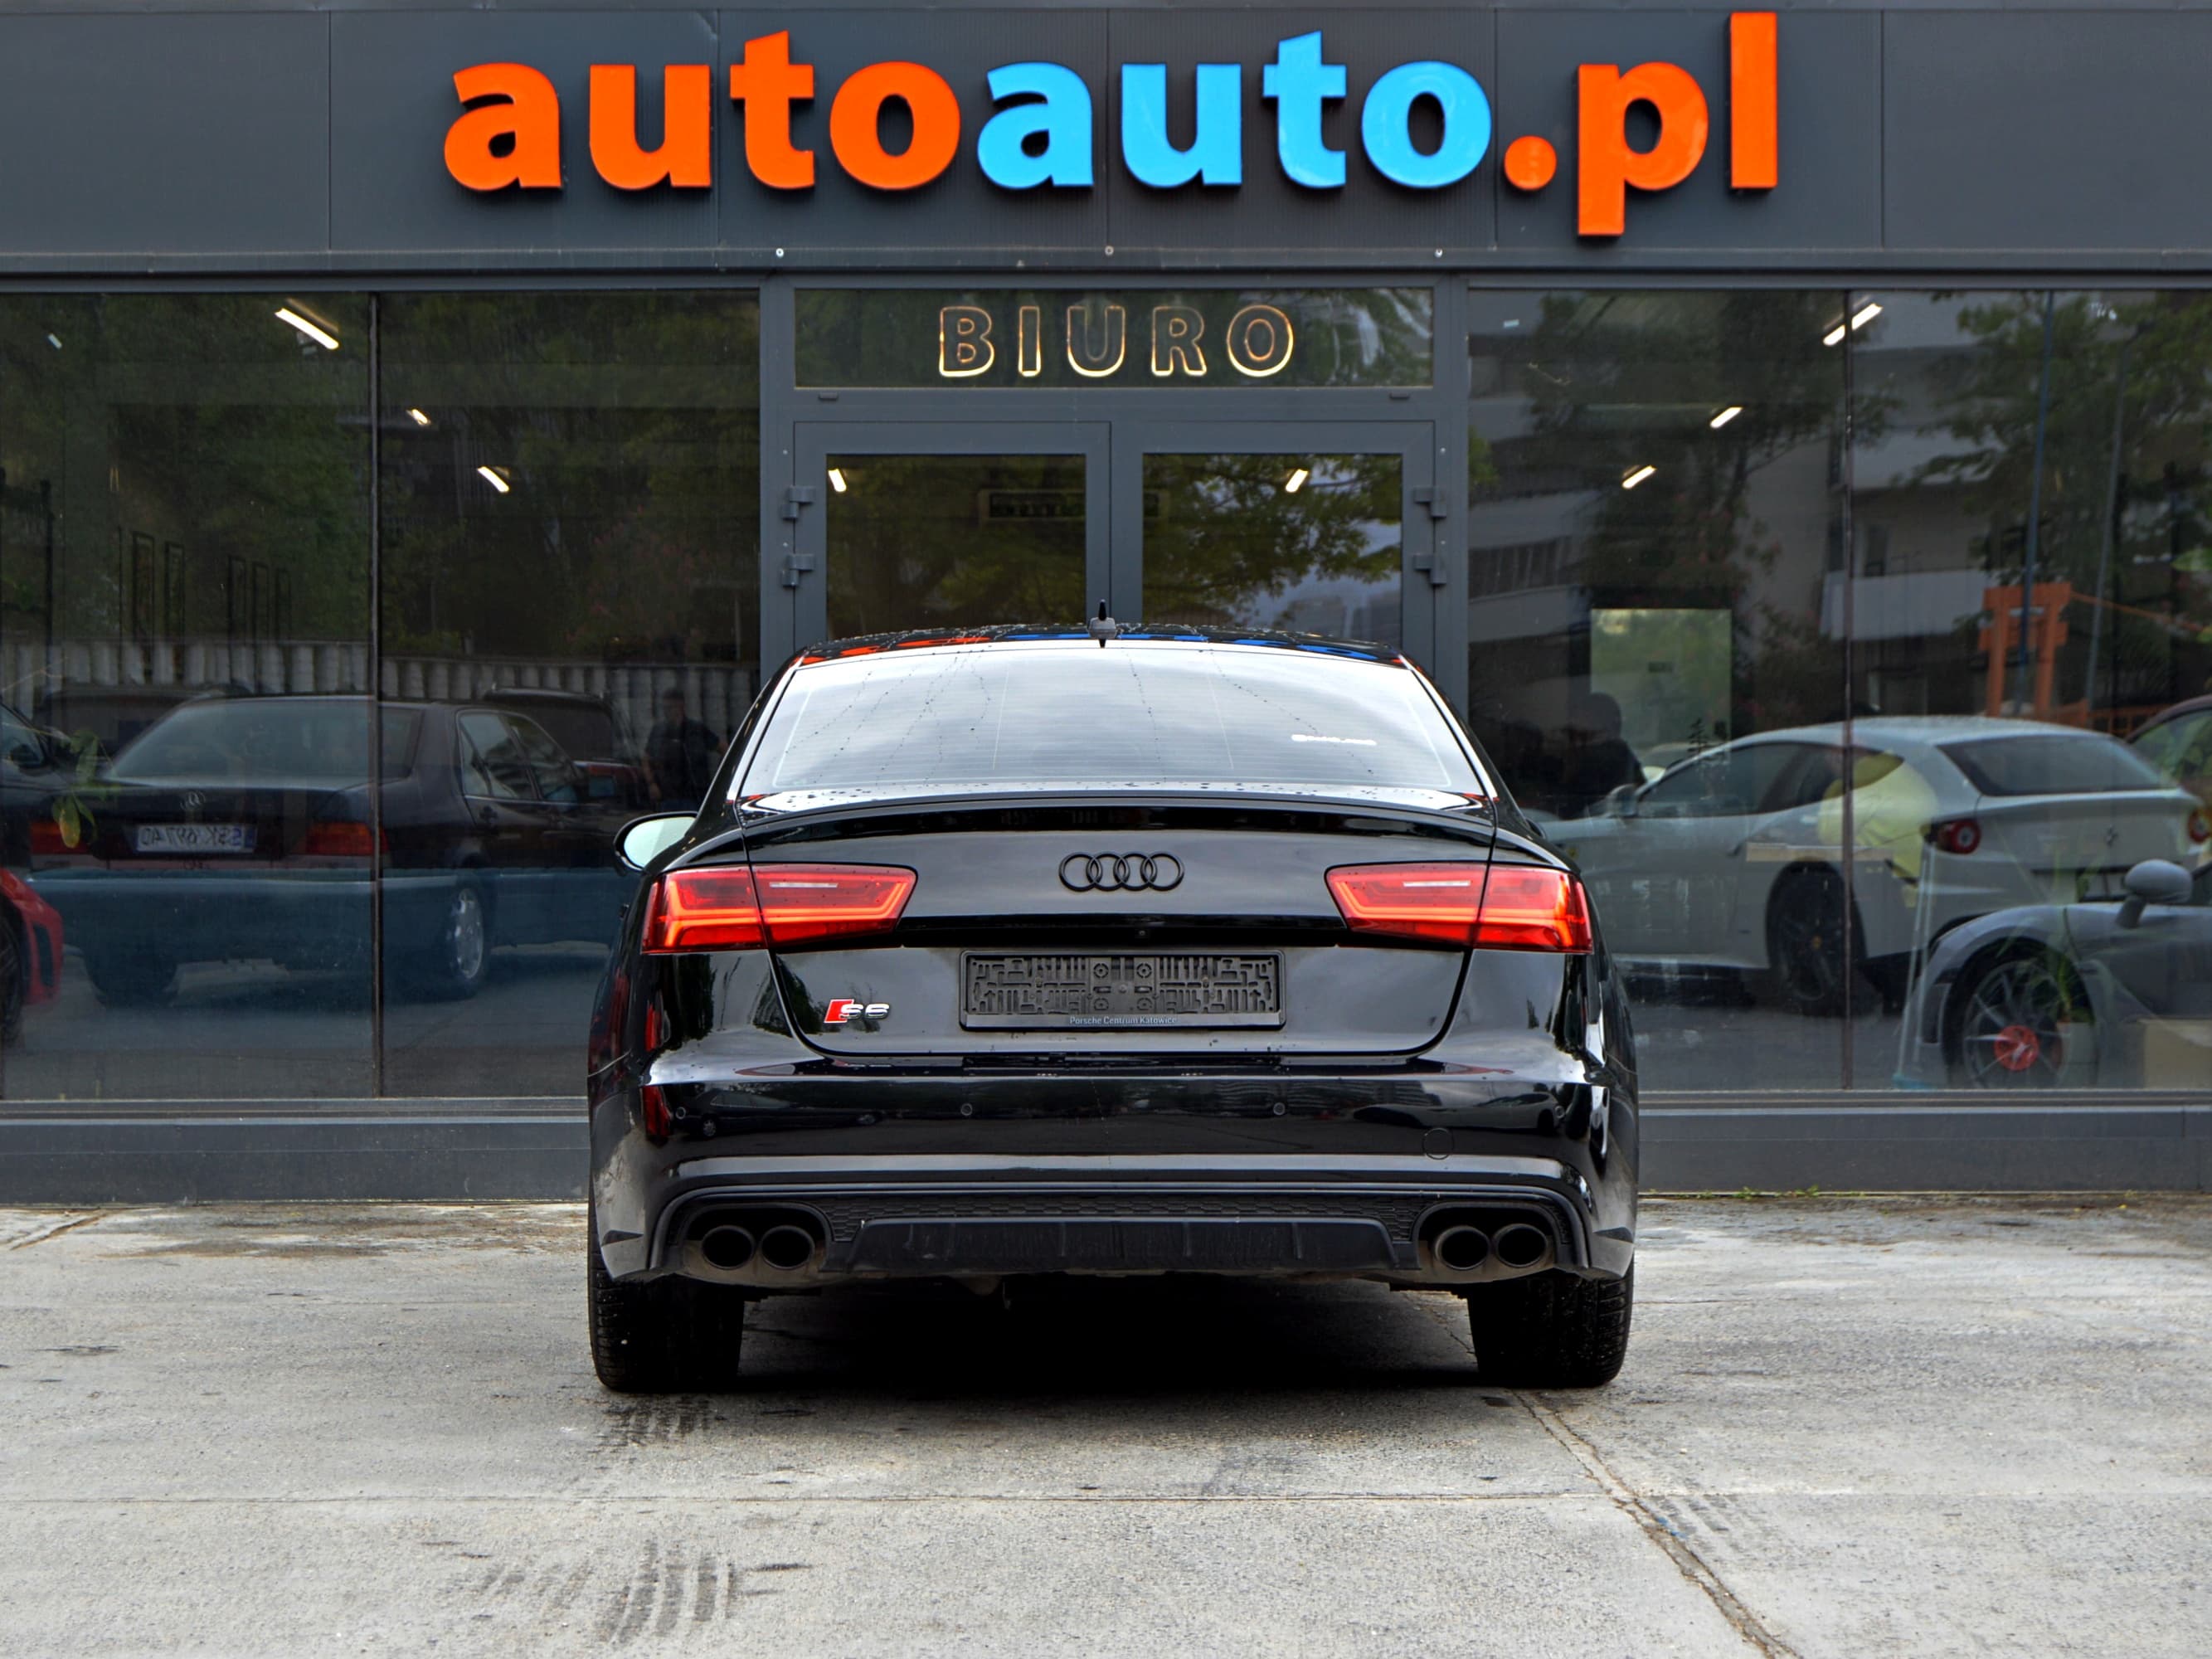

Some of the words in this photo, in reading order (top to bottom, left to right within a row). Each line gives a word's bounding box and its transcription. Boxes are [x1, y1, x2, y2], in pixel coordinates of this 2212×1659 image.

[445, 12, 1777, 237] autoauto.pl
[939, 304, 1294, 377] BIURO
[838, 1002, 890, 1020] S6
[1069, 1015, 1102, 1025] Porsche
[1103, 1015, 1138, 1025] Centrum
[1140, 1015, 1177, 1024] Katowice
